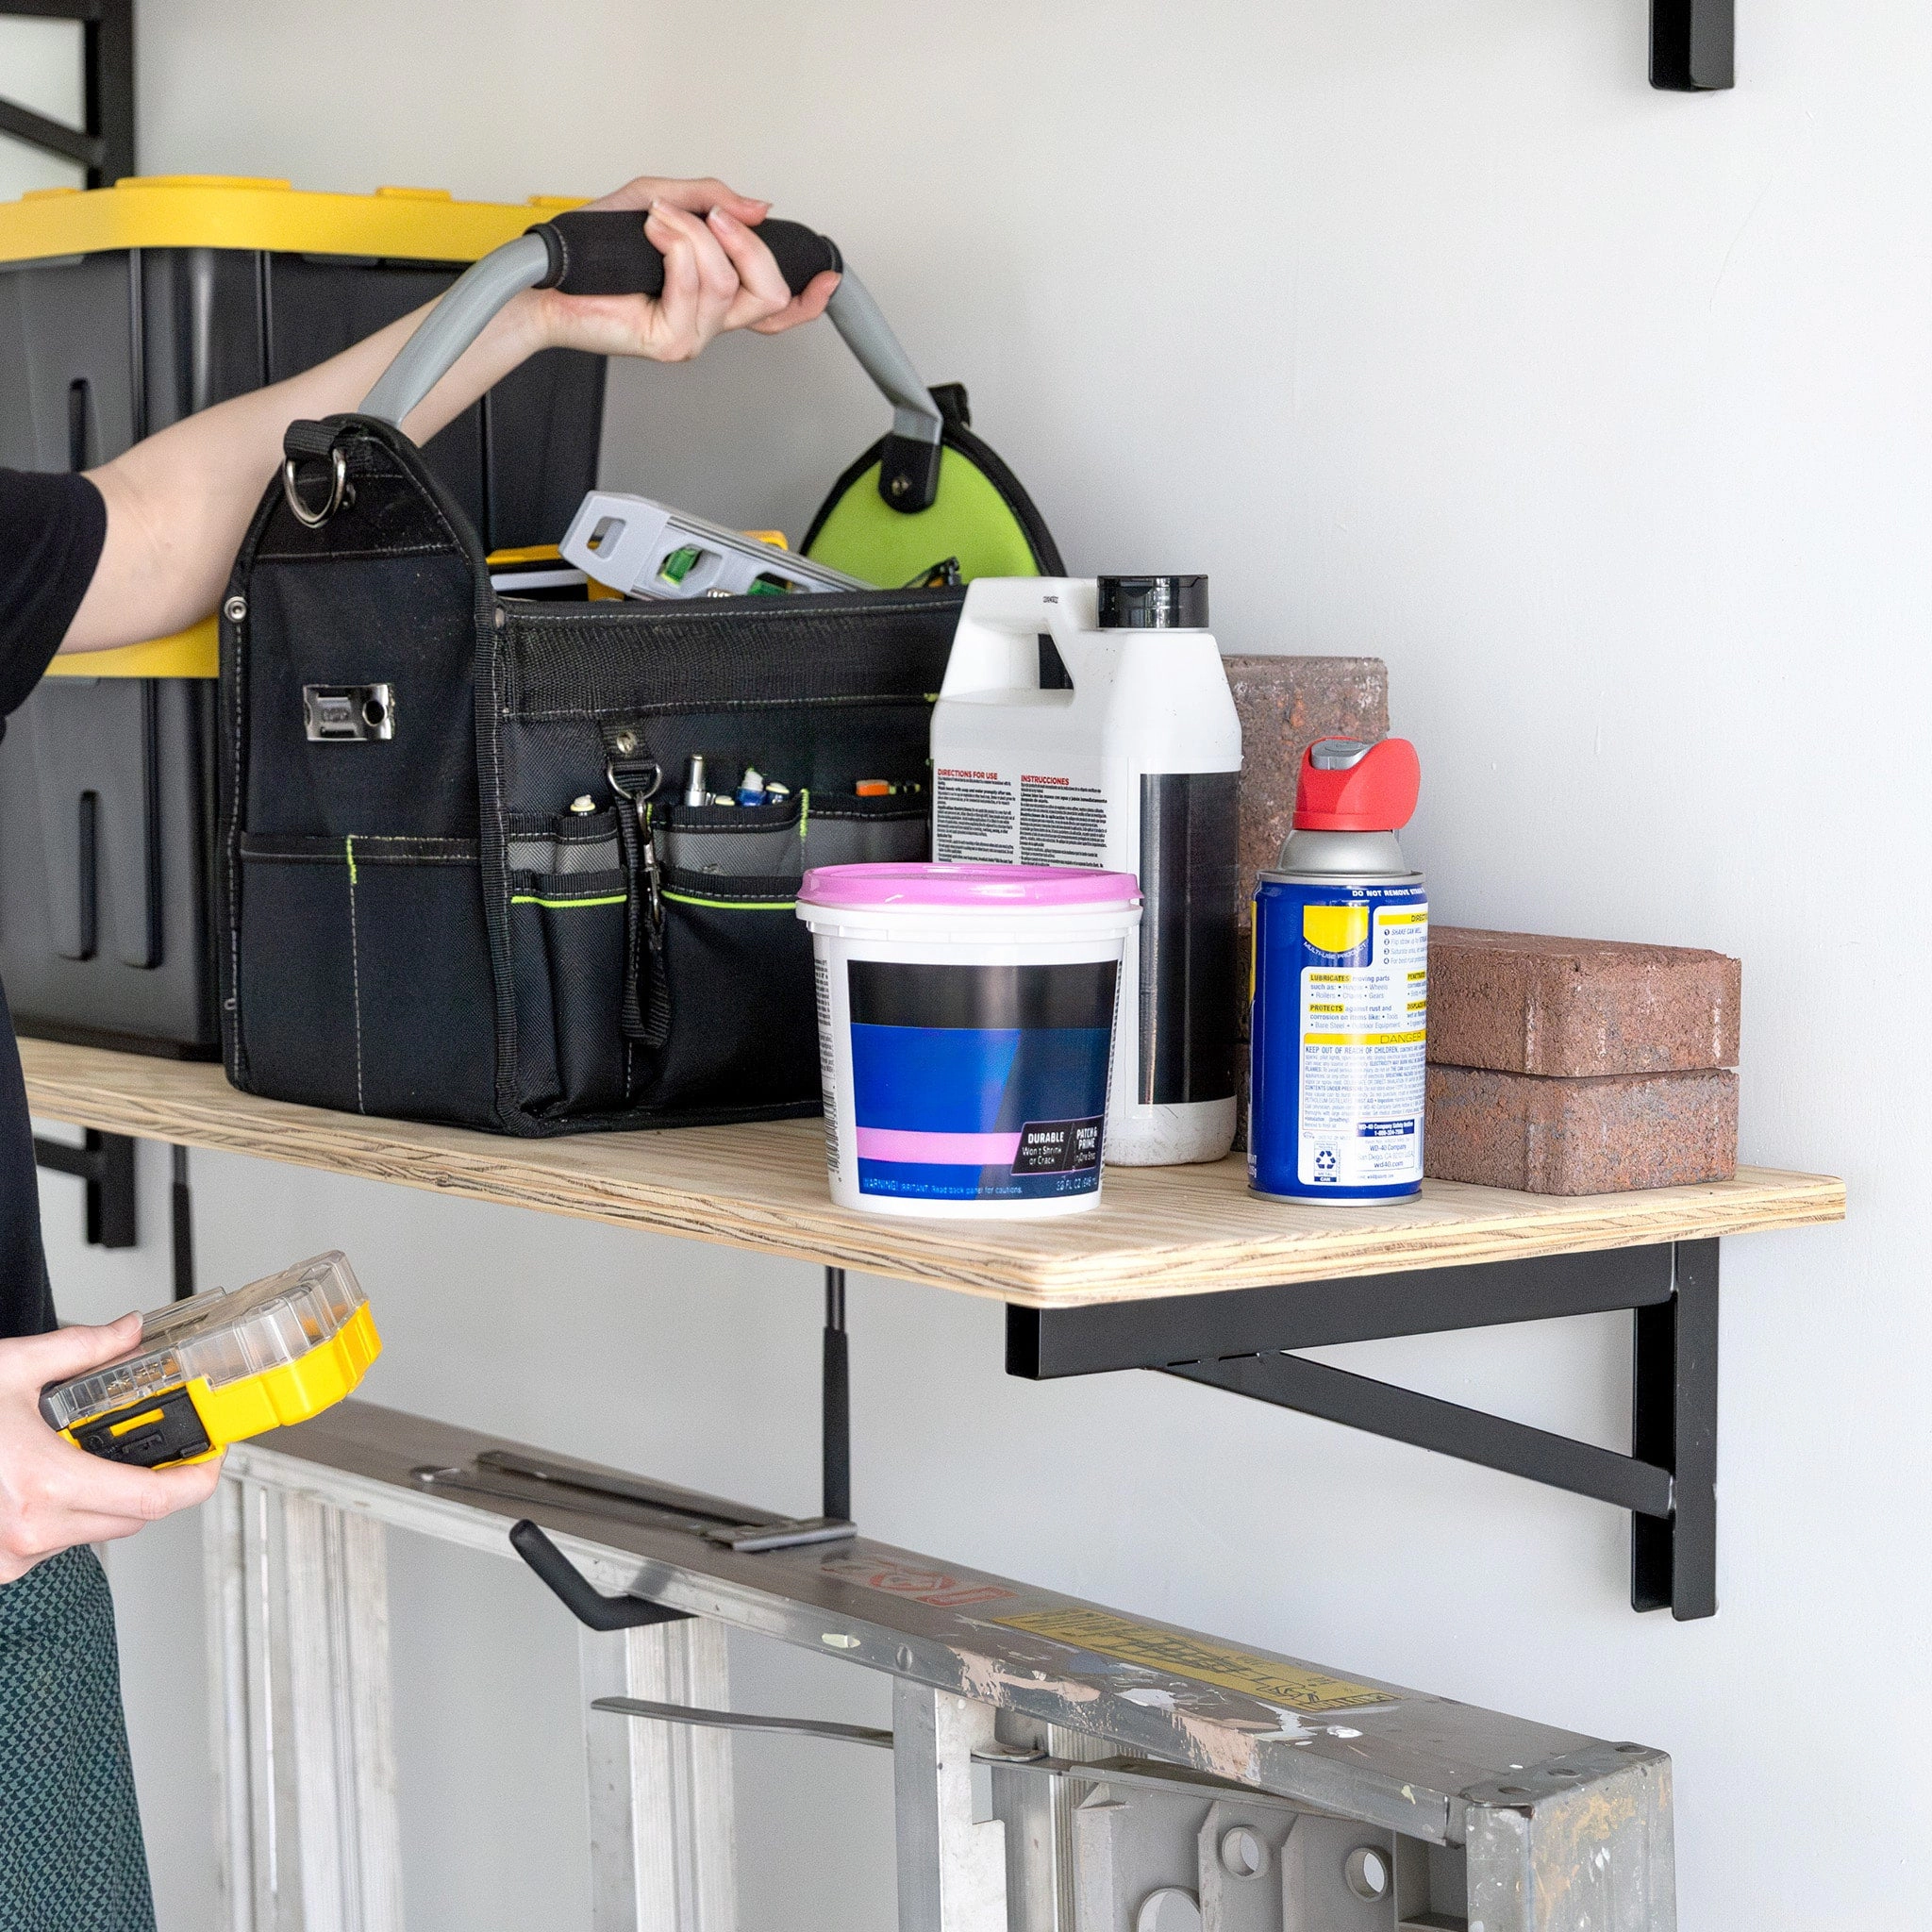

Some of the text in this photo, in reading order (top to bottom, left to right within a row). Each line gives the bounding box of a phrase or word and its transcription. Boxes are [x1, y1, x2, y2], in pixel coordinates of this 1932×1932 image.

[938, 769, 972, 777] DIRECTIONS
[973, 771, 985, 779] FOR
[1021, 774, 1070, 785] INSTRUCCIONES
[1380, 1032, 1422, 1044] DANGER
[1027, 1131, 1064, 1144] DURABLE
[1076, 1128, 1094, 1140] PATCH
[1078, 1138, 1095, 1150] PRIME
[1038, 1156, 1055, 1165] Crack
[863, 1177, 898, 1191] WARNING!
[984, 1186, 993, 1194] for
